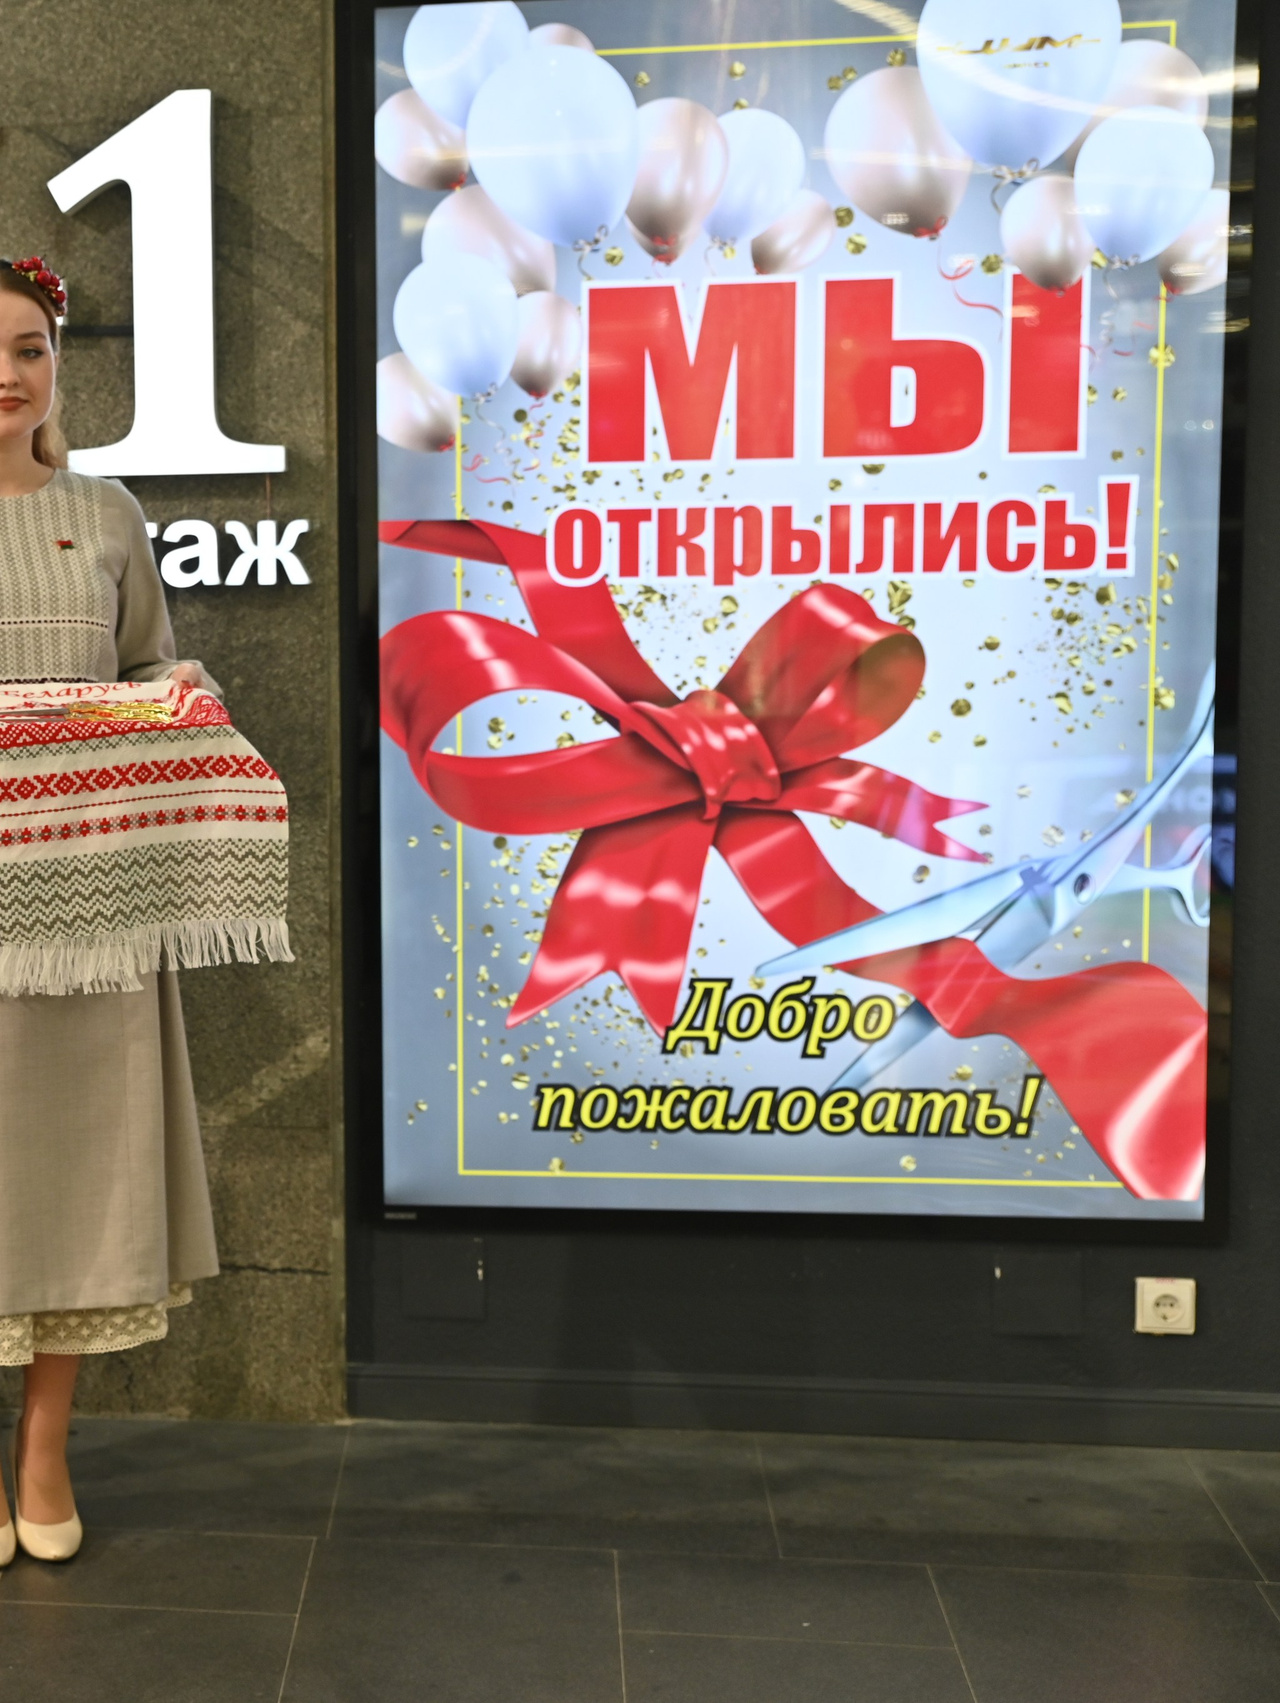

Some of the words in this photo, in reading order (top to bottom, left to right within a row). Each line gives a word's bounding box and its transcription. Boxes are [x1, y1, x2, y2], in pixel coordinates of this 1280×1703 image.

[586, 272, 1084, 463] МЫ
[553, 483, 1132, 586] открылись!
[664, 977, 897, 1057] Добро
[533, 1074, 1045, 1137] пожаловать!
